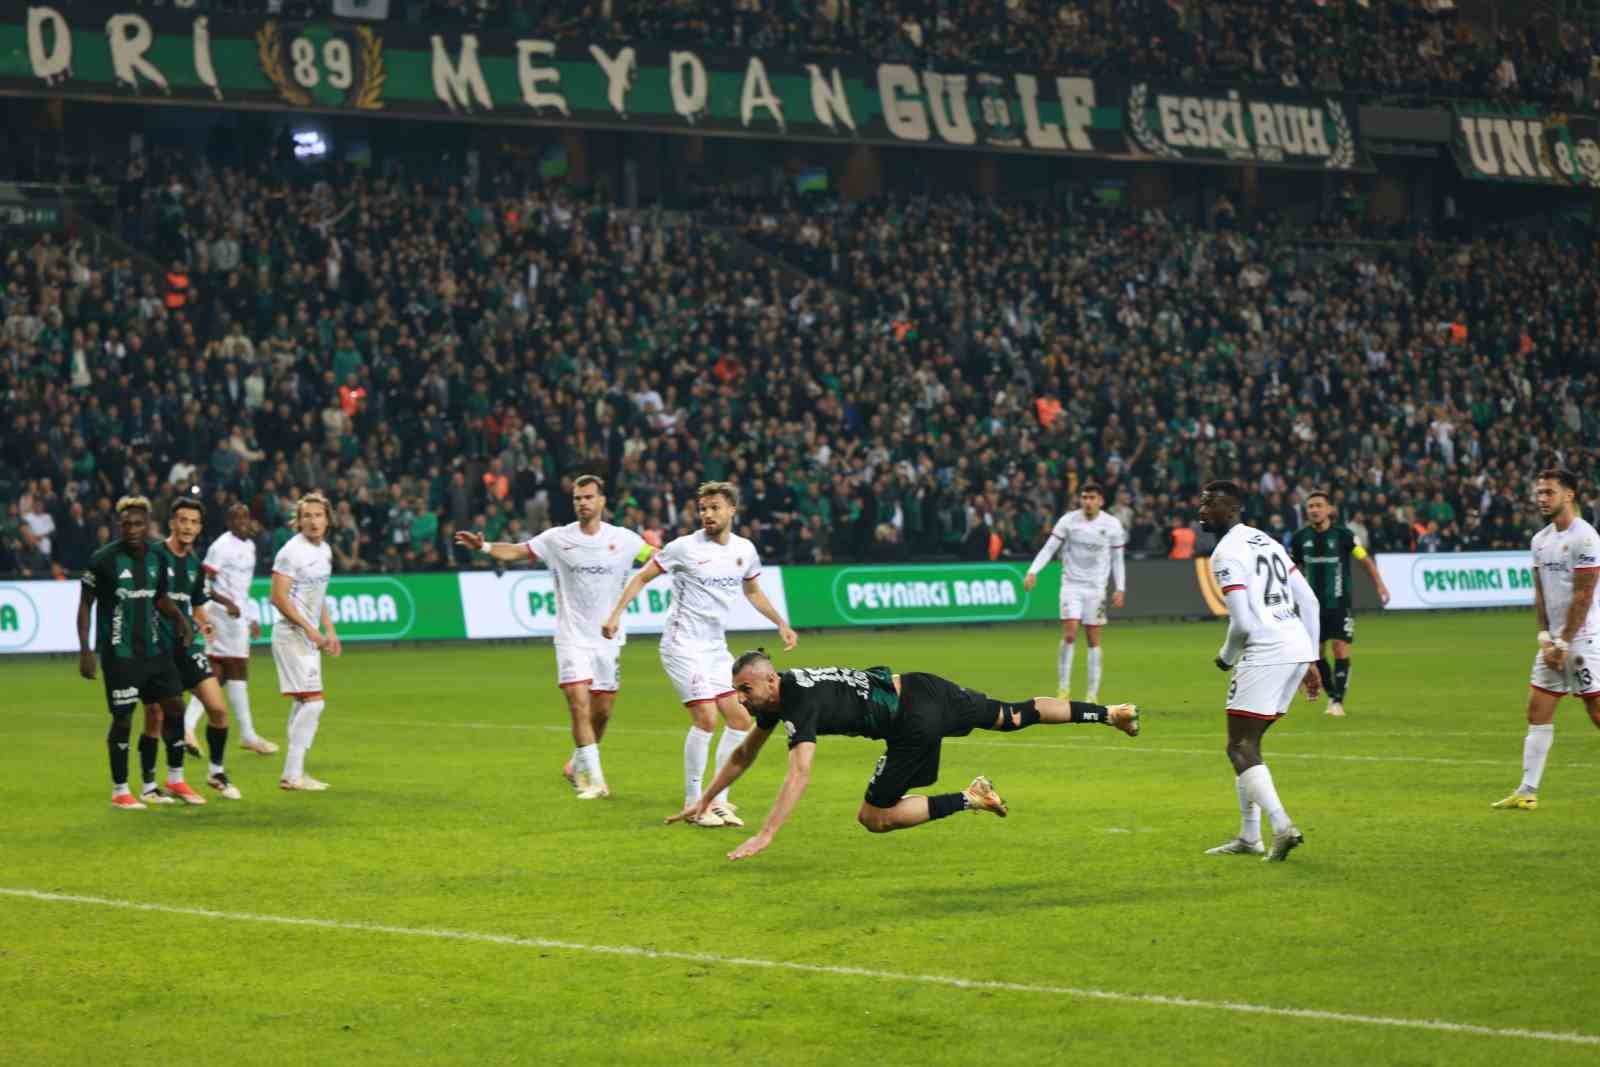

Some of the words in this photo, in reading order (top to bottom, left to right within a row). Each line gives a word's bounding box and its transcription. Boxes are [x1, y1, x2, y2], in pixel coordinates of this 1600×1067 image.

[290, 36, 353, 89] 89
[429, 33, 857, 133] MEYDAN
[1249, 101, 1331, 156] RUH
[953, 579, 1017, 606] BABA
[1256, 552, 1290, 606] 29
